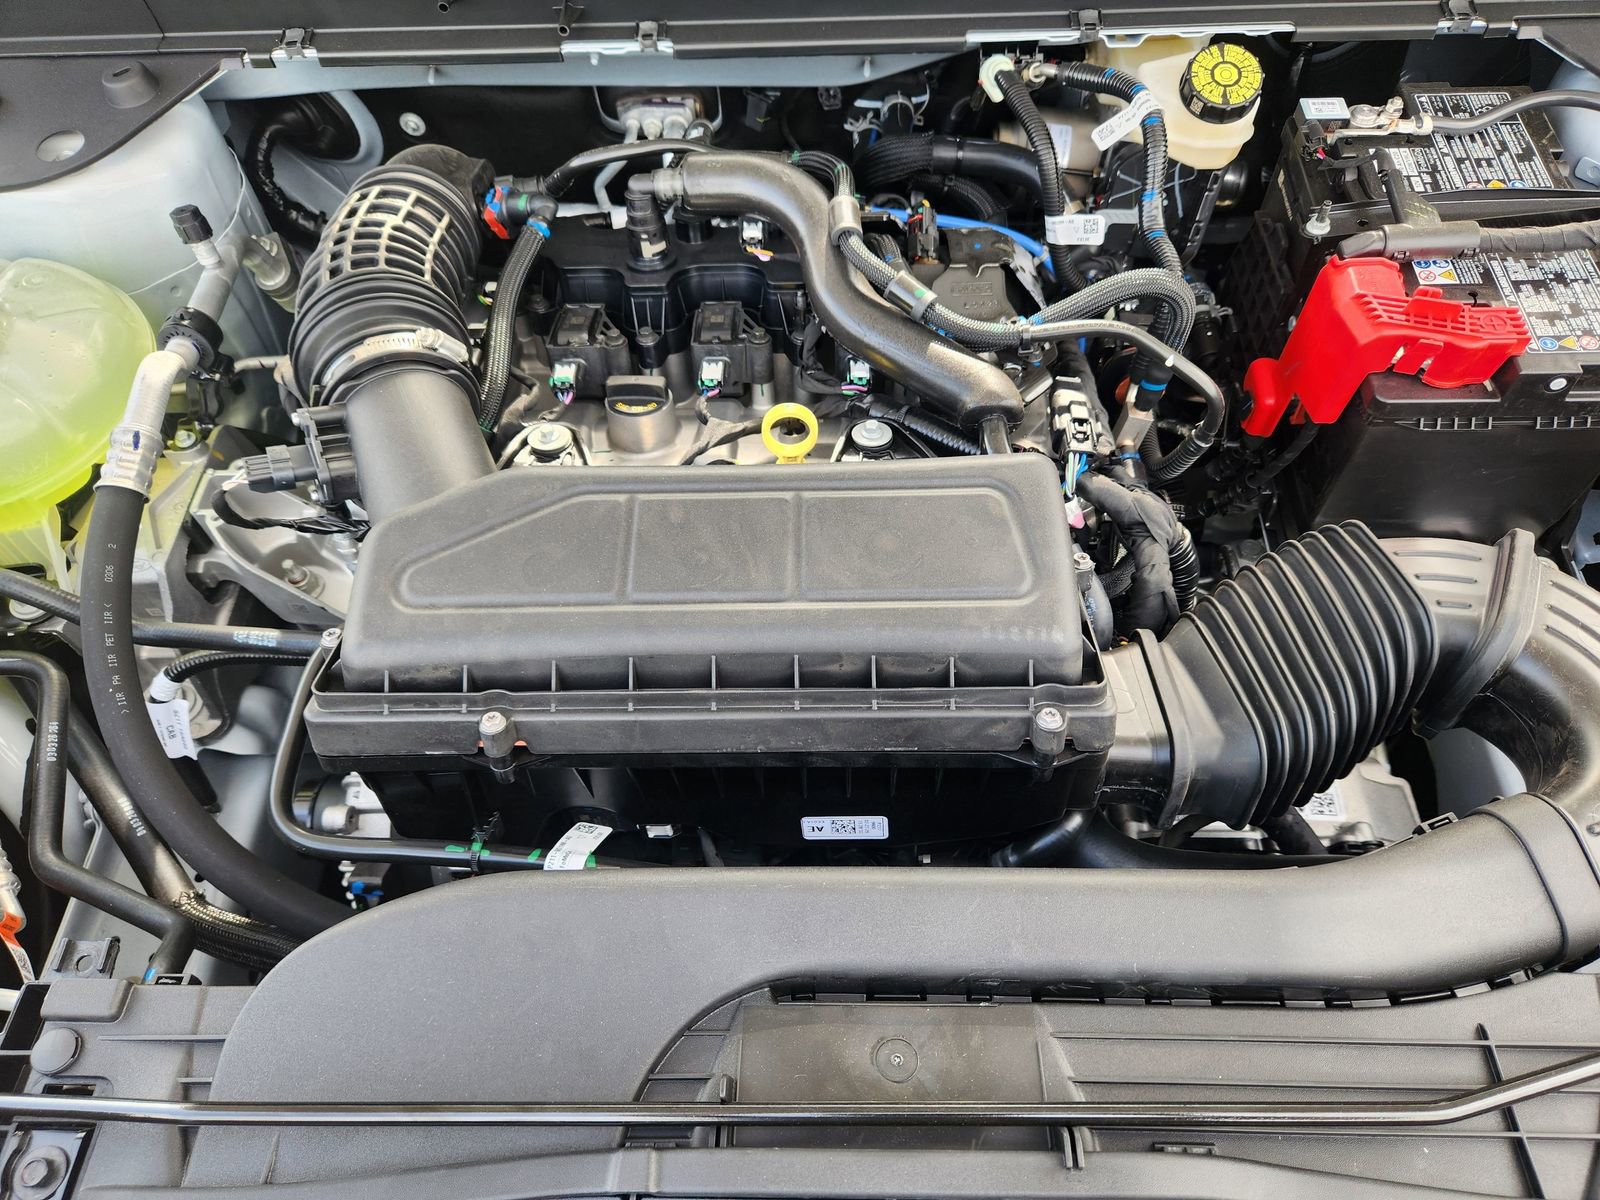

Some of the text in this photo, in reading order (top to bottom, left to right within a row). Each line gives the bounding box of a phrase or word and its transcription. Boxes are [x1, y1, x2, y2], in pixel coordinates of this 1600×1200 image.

[1414, 148, 1427, 170] FoMoCo
[104, 564, 114, 583] 0306
[104, 633, 115, 647] PET
[112, 674, 122, 686] PA
